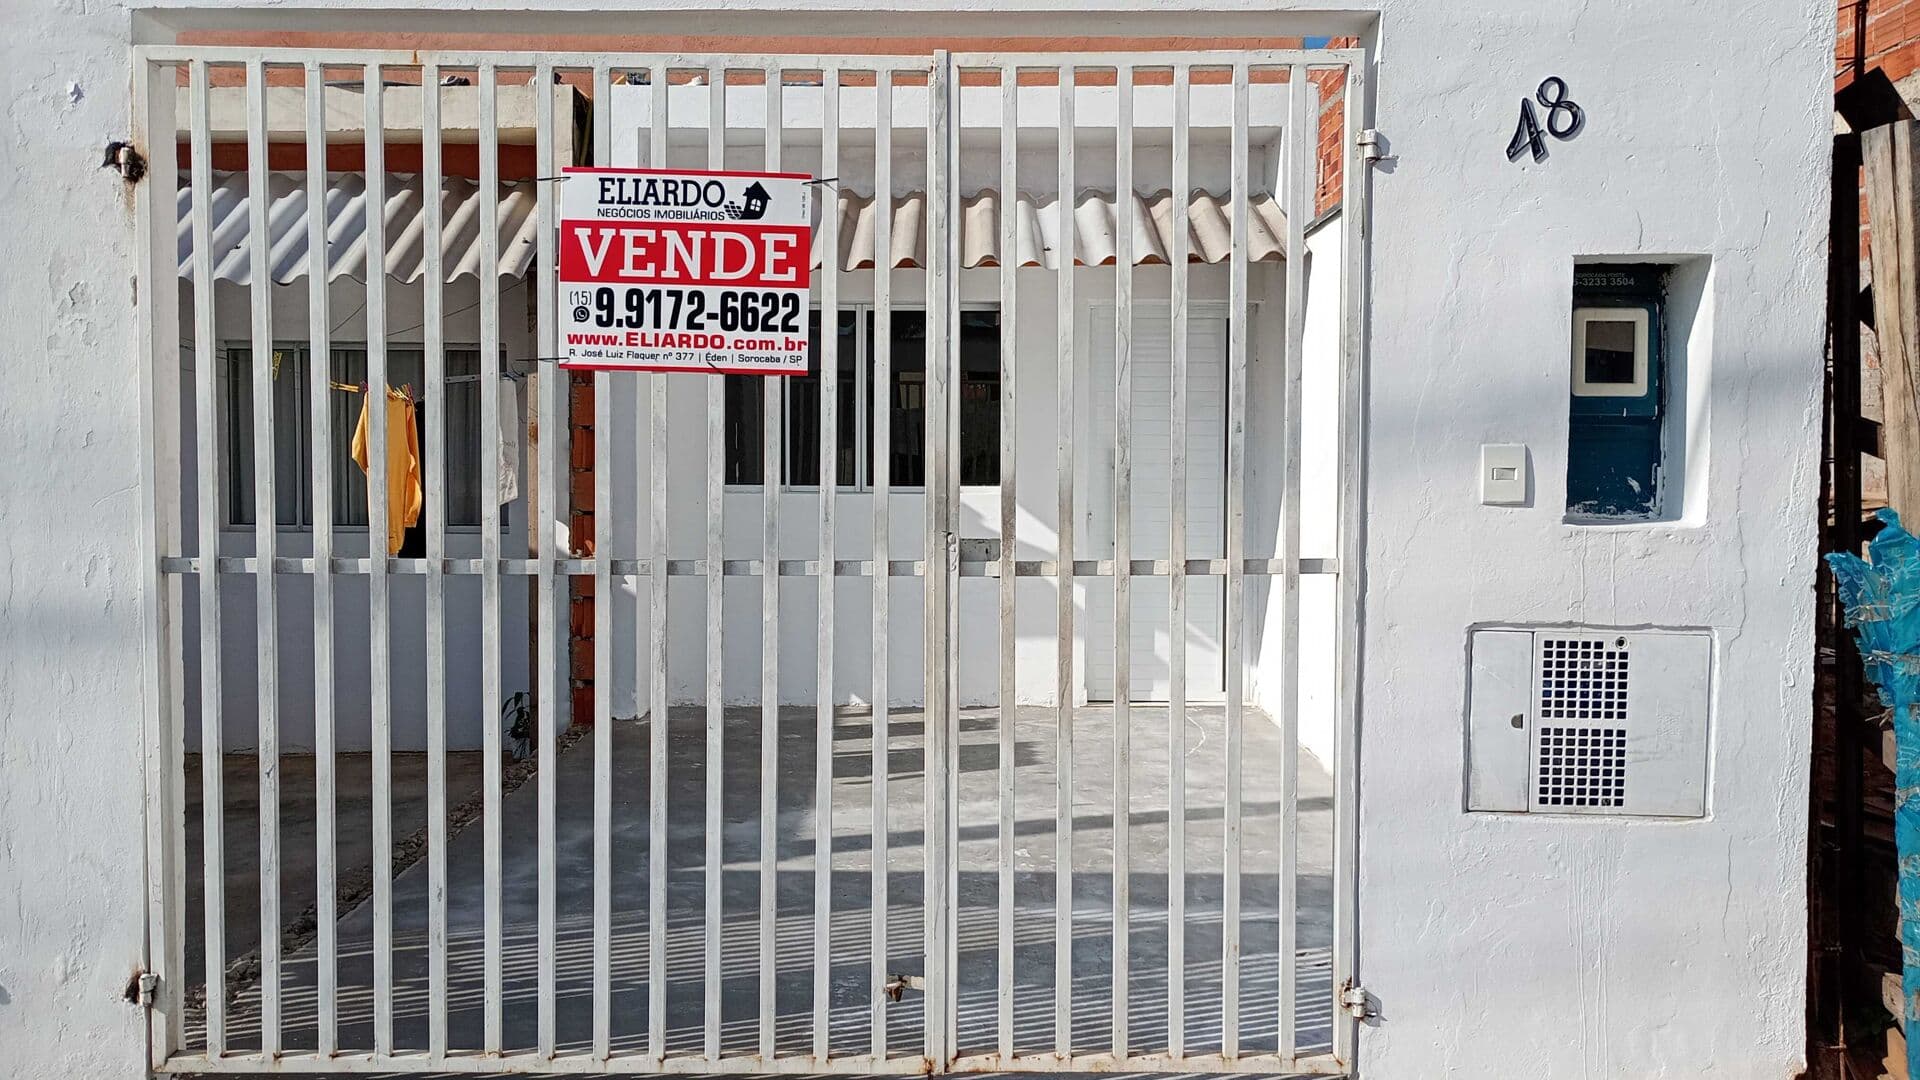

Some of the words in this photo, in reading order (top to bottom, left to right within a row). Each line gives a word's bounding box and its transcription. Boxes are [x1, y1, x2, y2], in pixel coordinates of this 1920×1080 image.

[1505, 76, 1581, 161] 48
[598, 177, 726, 208] ELIARDO
[597, 207, 651, 218] NEGÓCIOS
[654, 209, 725, 221] IMOBILIÁRIOS
[574, 227, 797, 282] VENDE
[1610, 277, 1635, 286] 3504
[569, 290, 592, 306] (15)
[595, 287, 800, 333] 9.9172-6622
[567, 332, 808, 351] www.ELIARDO.com.br
[569, 348, 578, 357] R.
[581, 349, 603, 358] José
[606, 350, 624, 359] Luiz
[626, 350, 660, 361] Flaquer
[675, 352, 694, 361] 377
[705, 352, 728, 362] Éden
[738, 354, 781, 363] Sorocaba
[789, 355, 803, 364] SP
